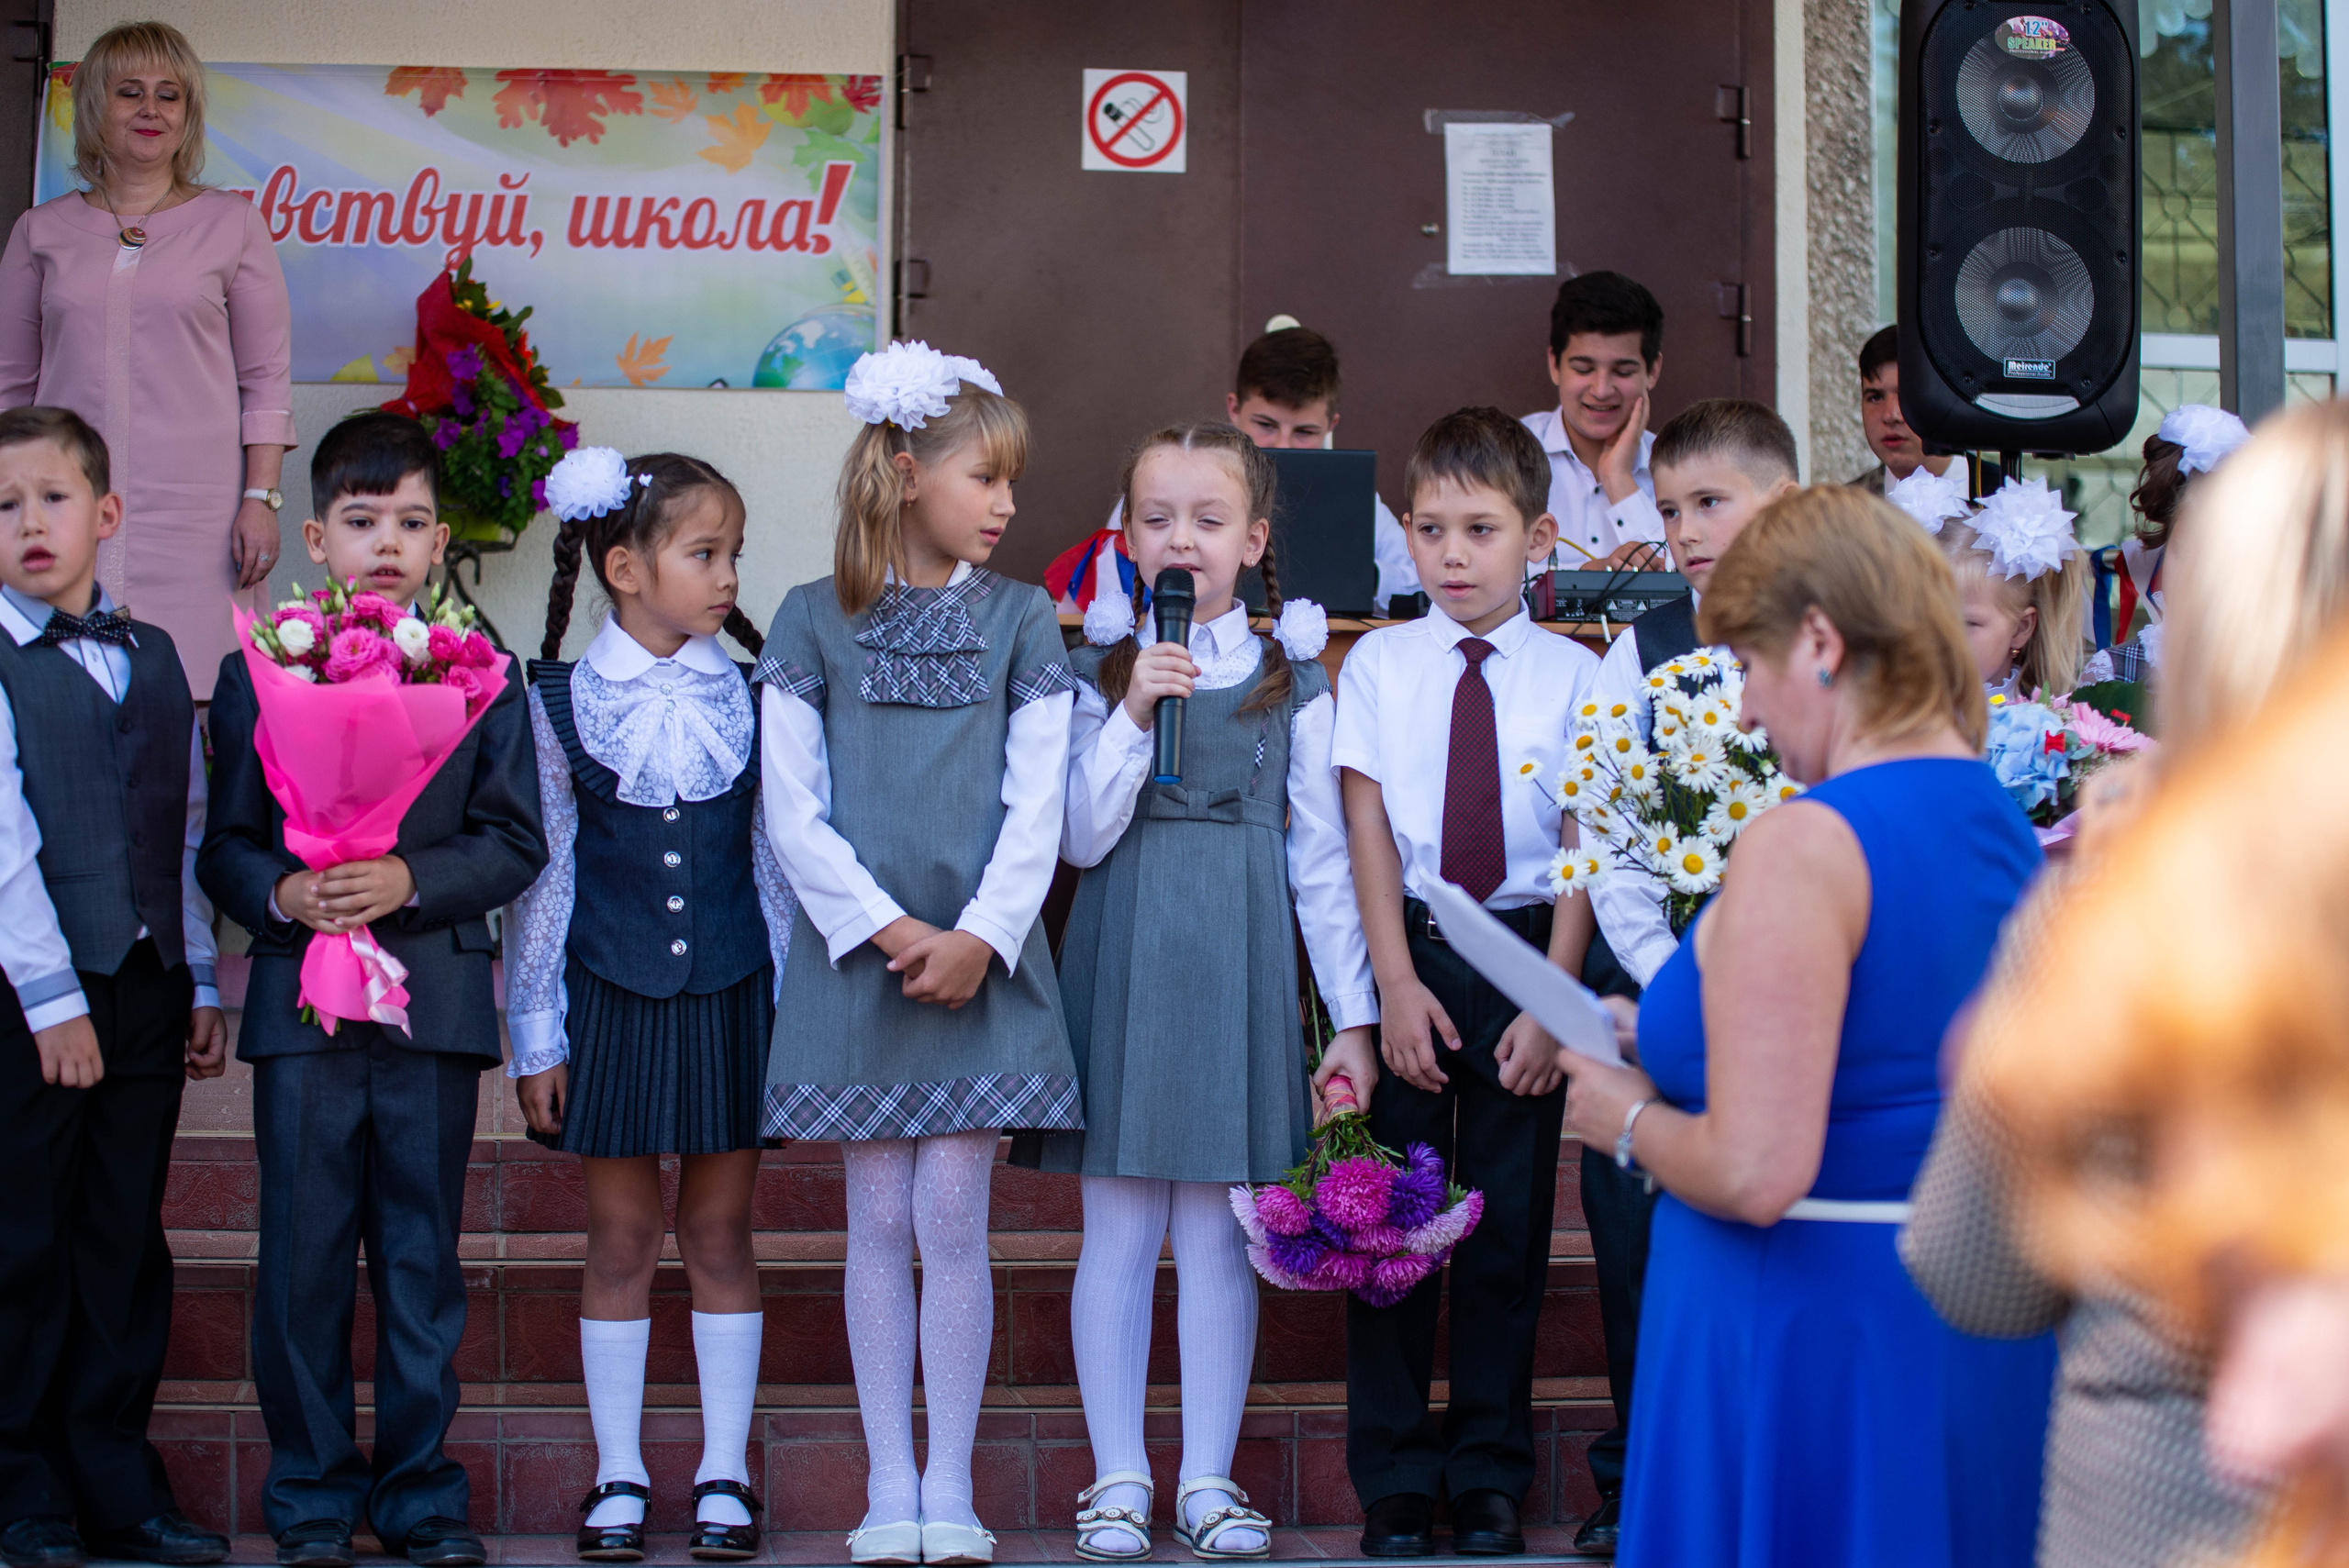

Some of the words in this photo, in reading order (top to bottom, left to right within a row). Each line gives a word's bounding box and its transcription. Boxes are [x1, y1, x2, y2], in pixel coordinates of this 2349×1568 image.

[2025, 20, 2049, 36] 12"
[2007, 37, 2056, 50] SPEAKER
[229, 163, 544, 270] вствуй,
[566, 163, 853, 255] школа!
[2008, 361, 2050, 372] Meirende
